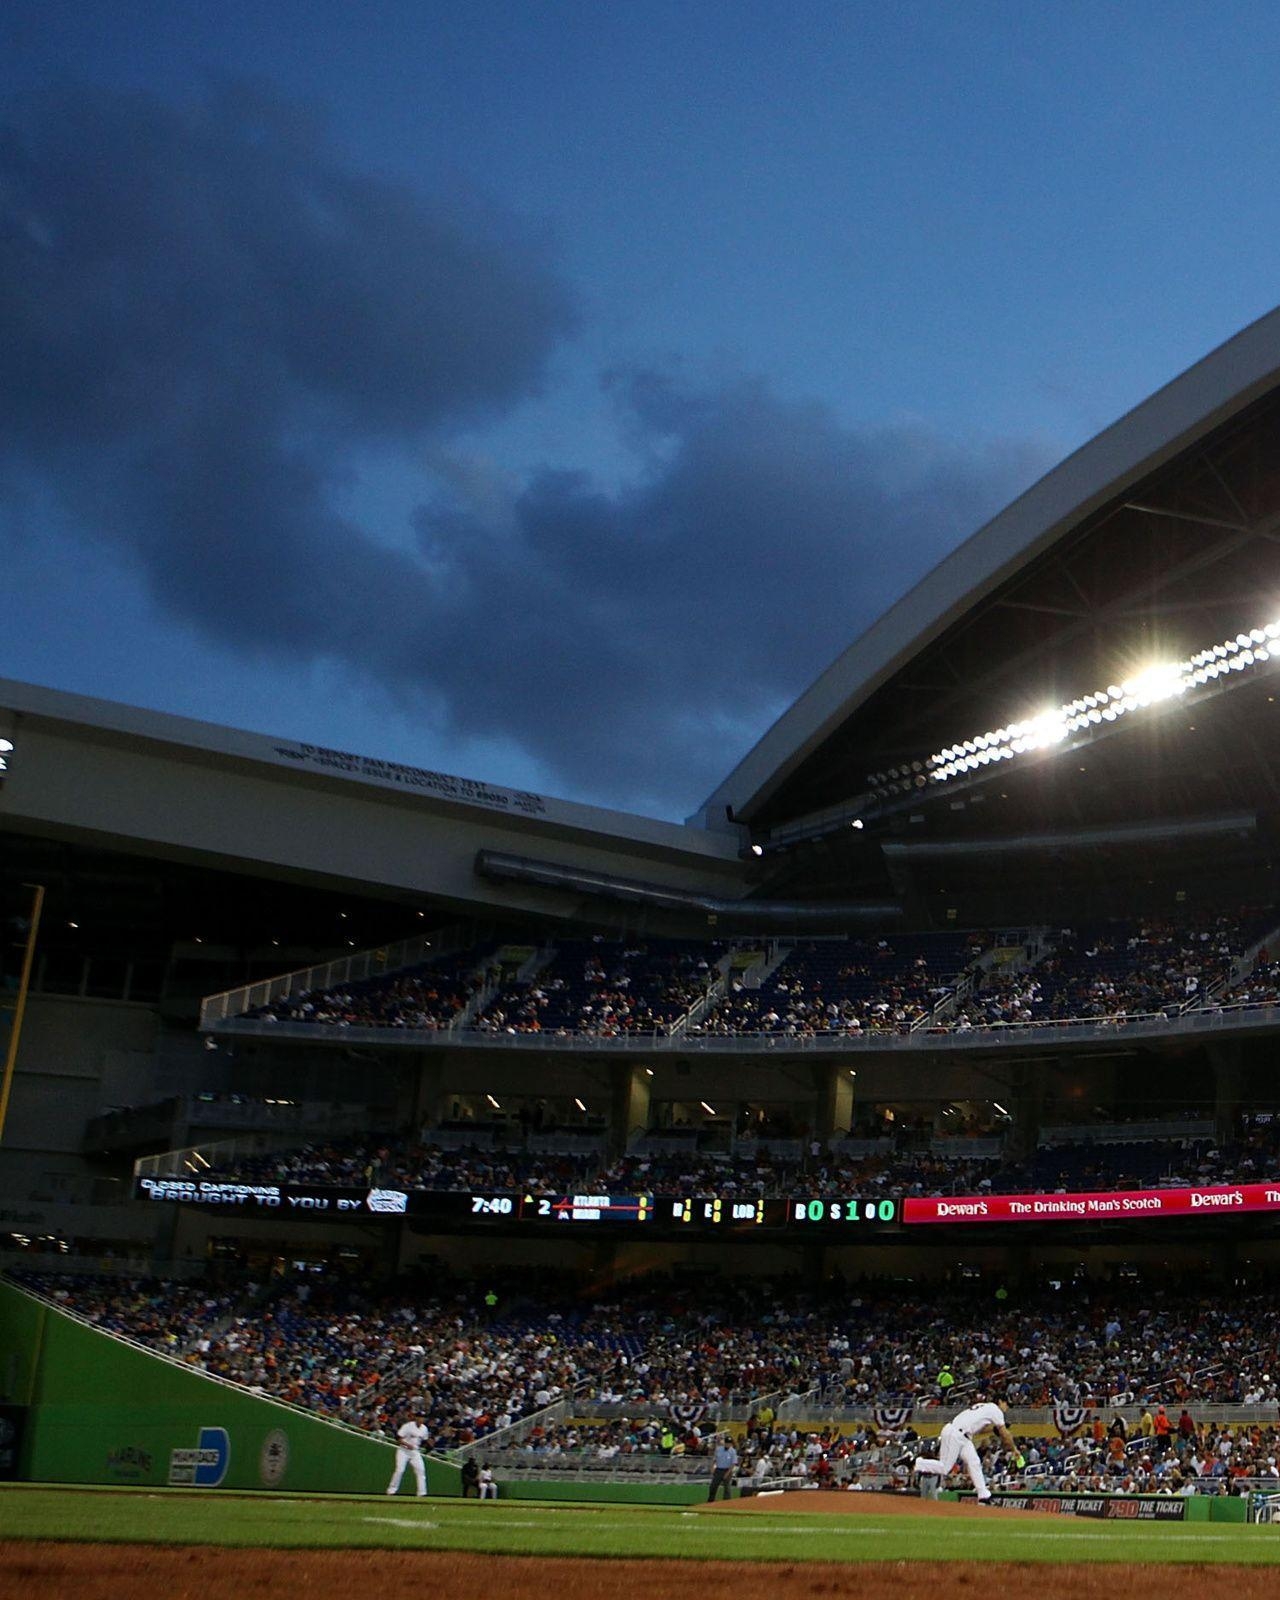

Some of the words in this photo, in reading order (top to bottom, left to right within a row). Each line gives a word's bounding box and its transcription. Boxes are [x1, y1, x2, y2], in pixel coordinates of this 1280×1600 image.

[472, 1197, 513, 1214] 7:40
[1009, 1202, 1031, 1213] The
[1034, 1201, 1085, 1213] Drinking
[1088, 1200, 1120, 1211] Man's
[1123, 1198, 1161, 1209] Scotch
[1191, 1191, 1242, 1206] Dewar's
[538, 1200, 551, 1215] 2
[809, 1200, 824, 1221] 0
[830, 1203, 841, 1220] S
[846, 1200, 860, 1221] 1
[879, 1200, 895, 1221] 0
[938, 1202, 987, 1216] Dewar's
[1076, 1499, 1105, 1512] TICKET
[1108, 1500, 1140, 1519] 790
[1139, 1500, 1156, 1513] THE
[1155, 1501, 1185, 1514] TICKET
